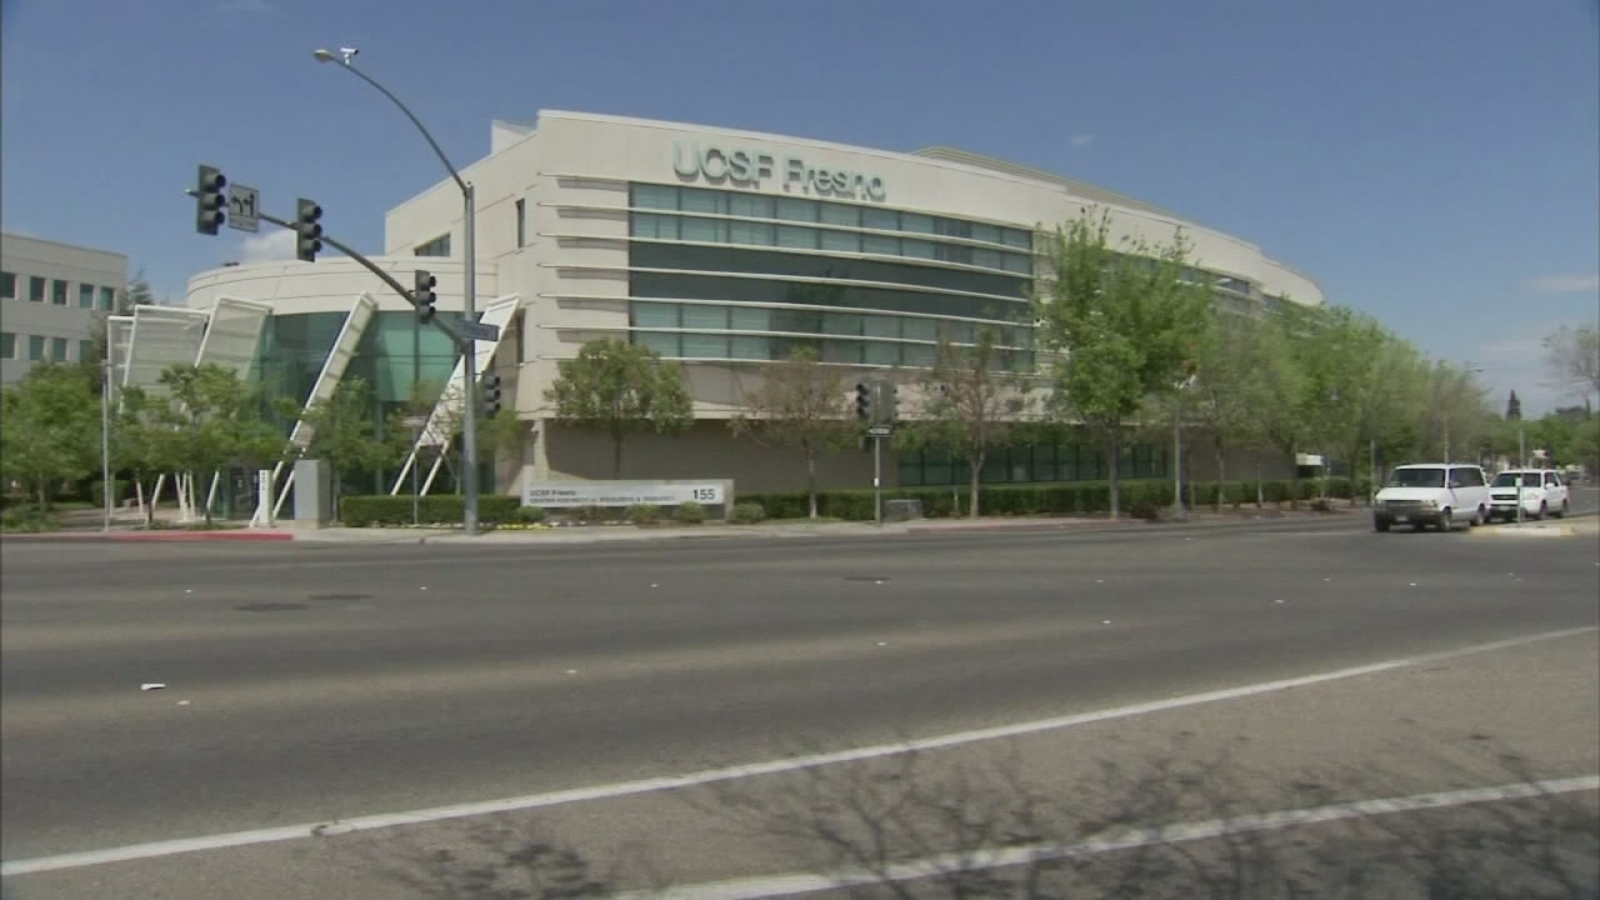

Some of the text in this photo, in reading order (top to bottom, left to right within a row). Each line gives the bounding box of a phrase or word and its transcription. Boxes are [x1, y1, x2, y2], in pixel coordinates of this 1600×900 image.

[672, 141, 886, 202] UCSF Fresno
[693, 489, 716, 500] 155
